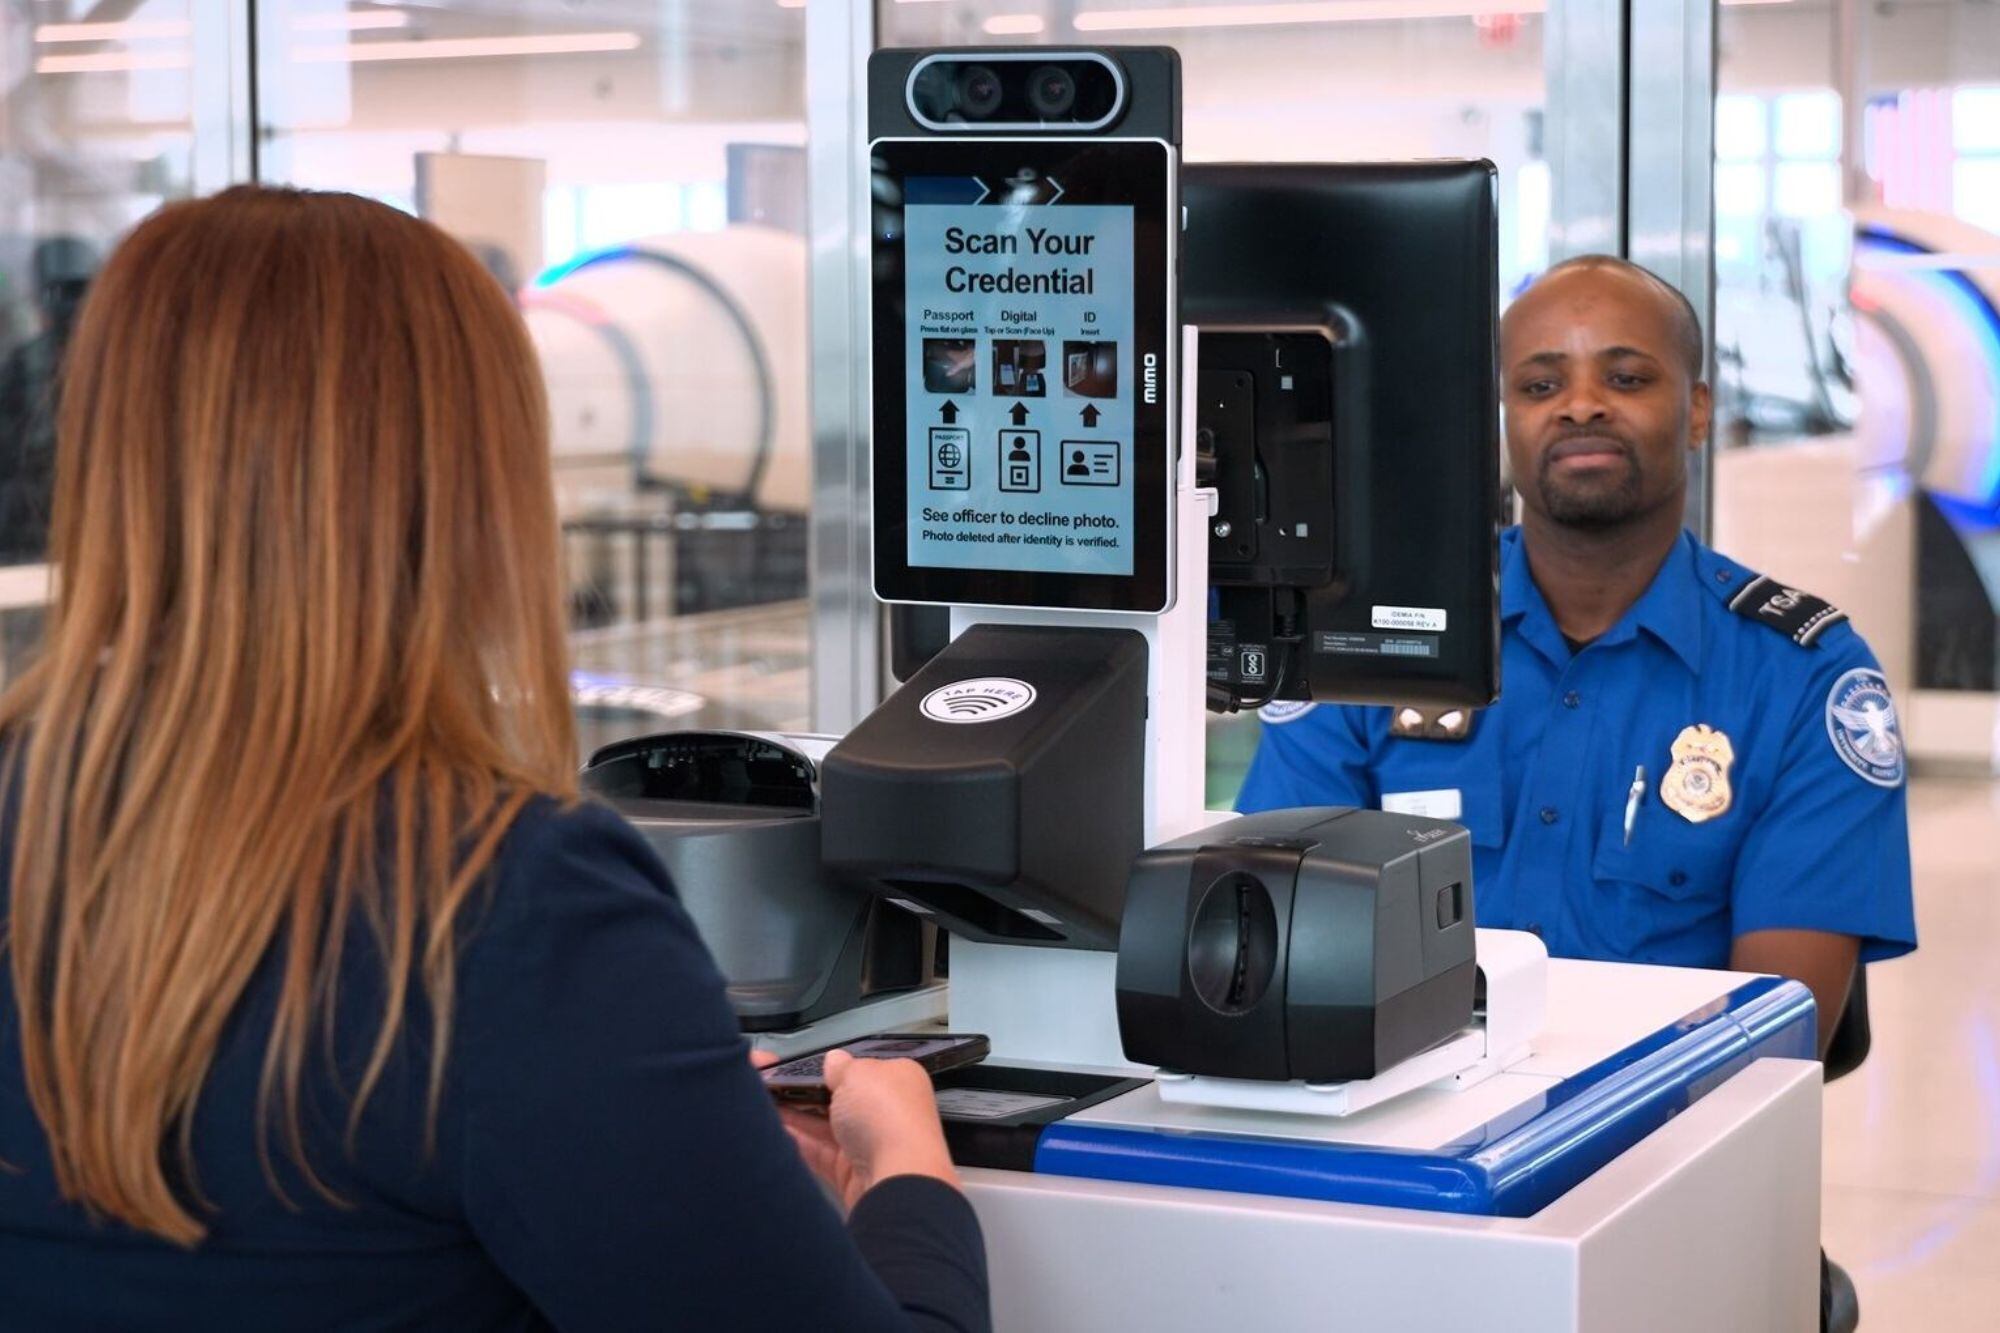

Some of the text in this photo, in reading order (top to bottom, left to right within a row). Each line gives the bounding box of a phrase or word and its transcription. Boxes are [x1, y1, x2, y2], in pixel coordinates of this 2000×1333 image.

[945, 227, 1095, 254] Scan Your
[945, 267, 1094, 294] Credential
[924, 309, 974, 323] Passport
[1001, 310, 1037, 324] Digital
[1083, 312, 1096, 323] ID
[1080, 328, 1100, 336] Insert
[1144, 353, 1156, 403] mimo
[922, 507, 1120, 530] See officer to decline photo.
[922, 530, 1119, 548] Photo deleted after identity is verified.
[1758, 589, 1801, 617] TSA
[945, 688, 1023, 700] TAP HERE
